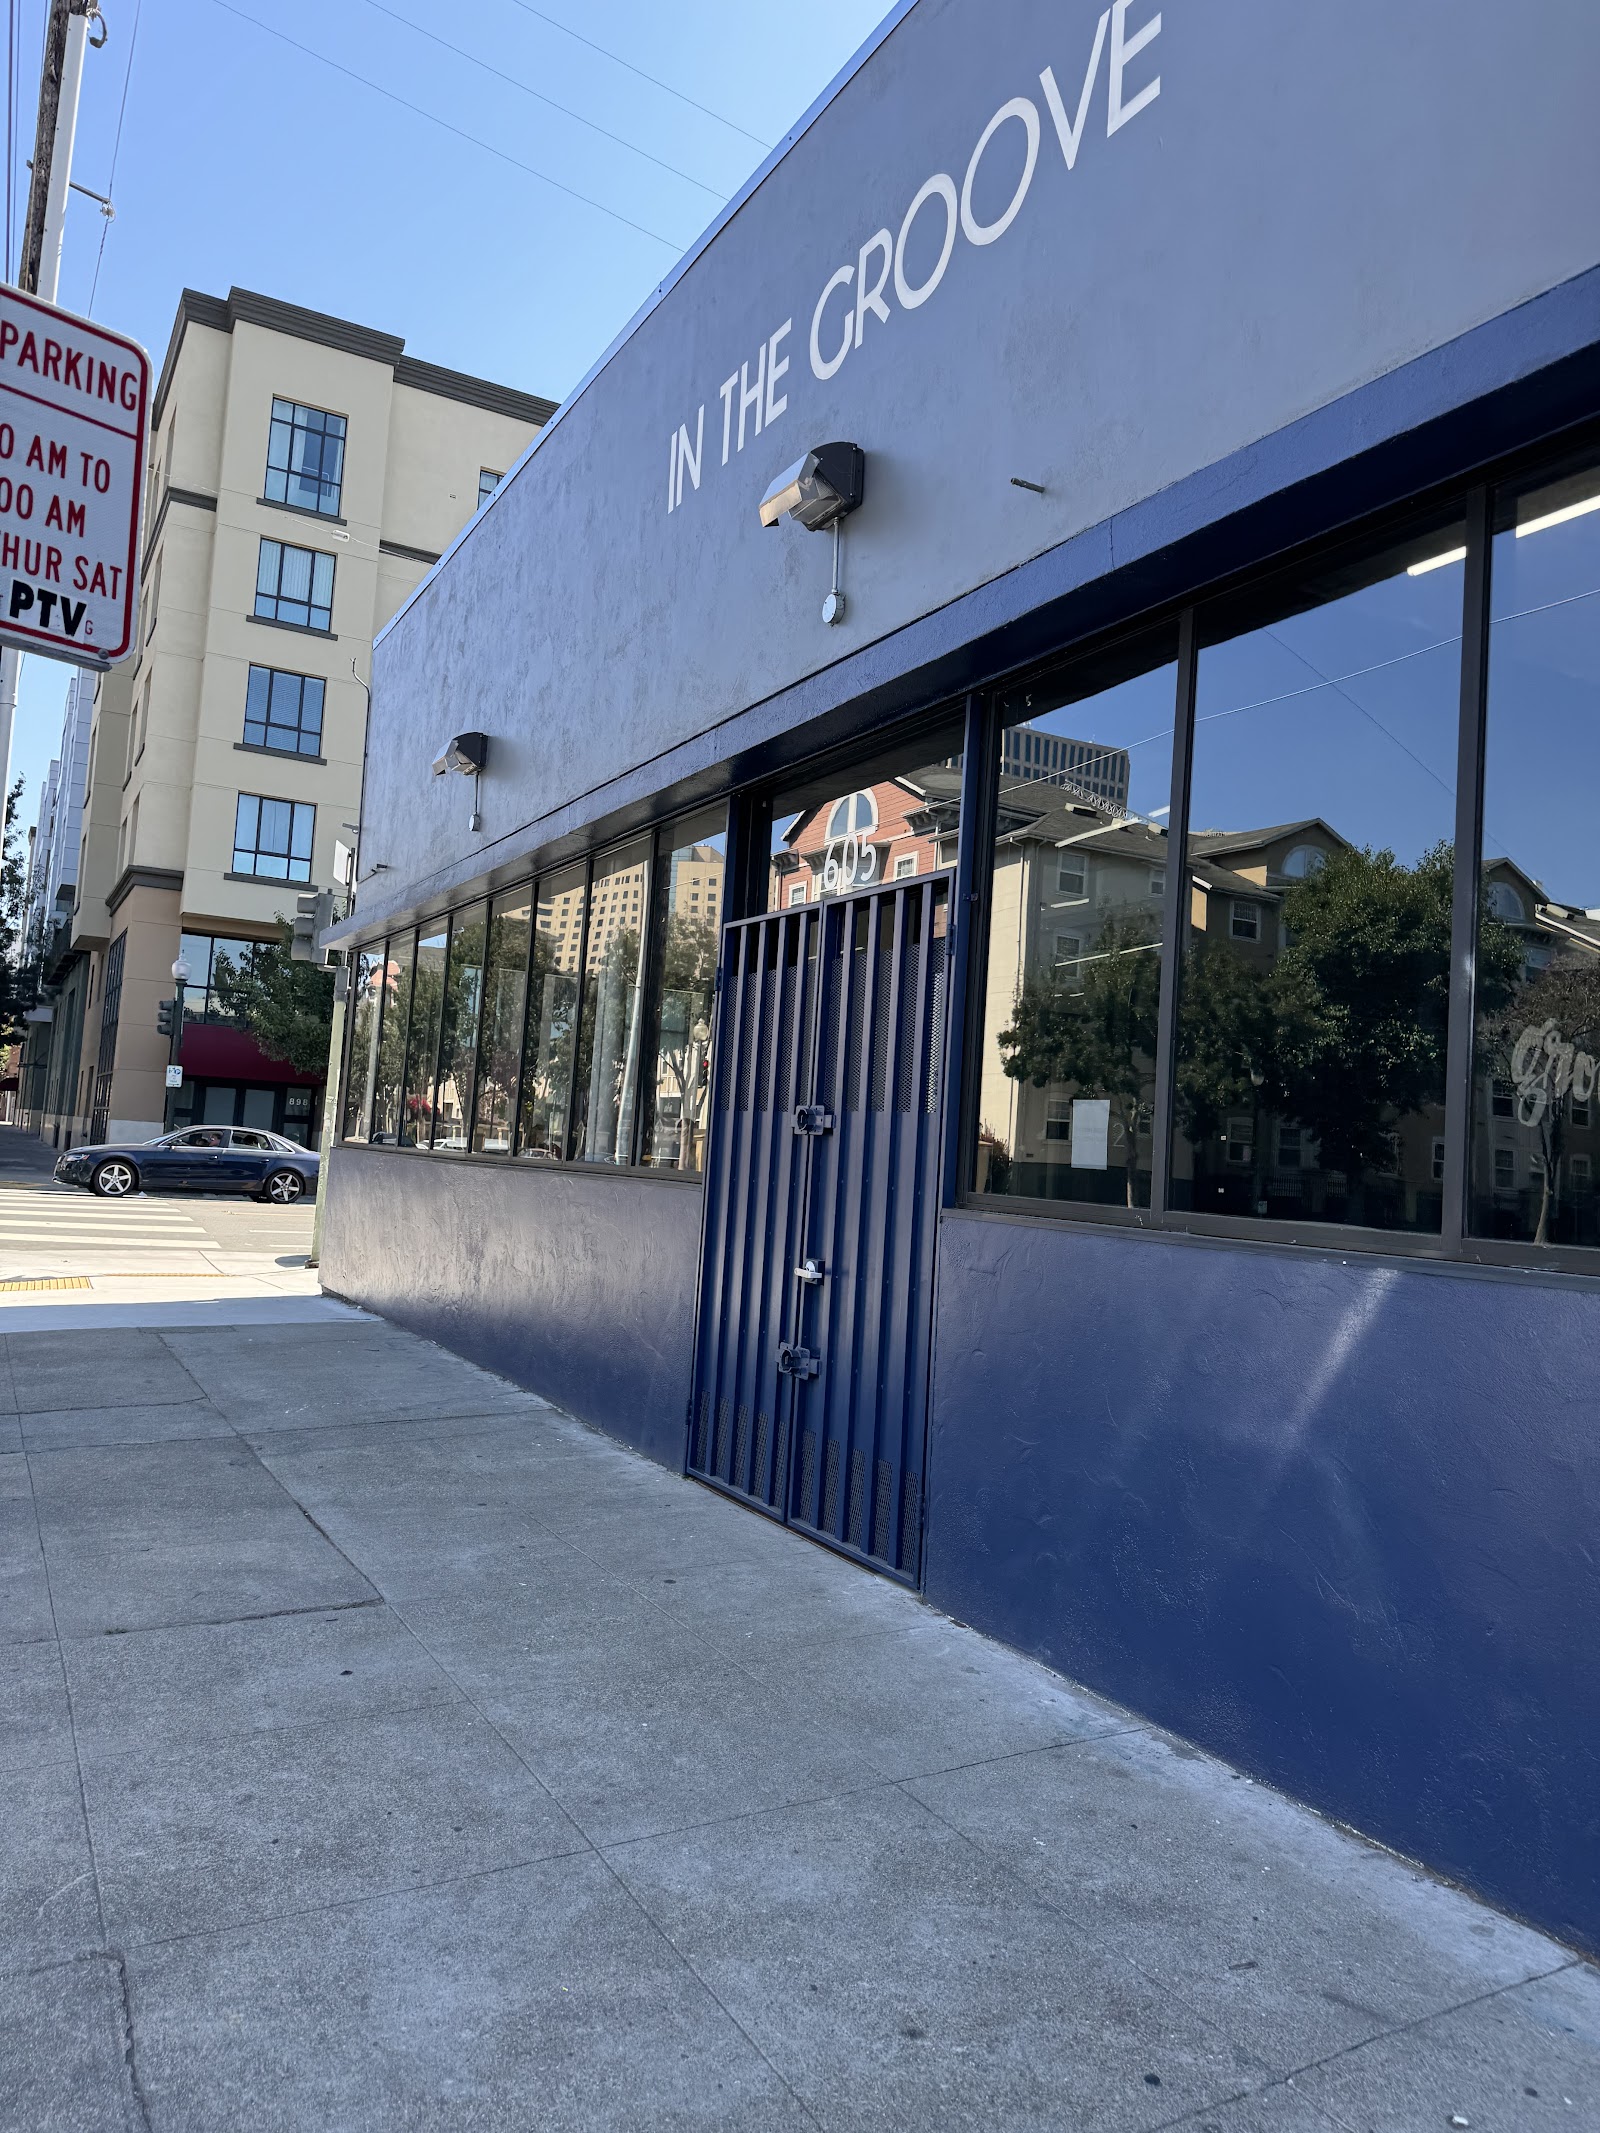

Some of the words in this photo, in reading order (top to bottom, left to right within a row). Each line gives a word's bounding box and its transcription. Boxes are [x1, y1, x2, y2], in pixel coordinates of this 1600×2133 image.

[667, 404, 705, 514] IN
[720, 317, 792, 466] THE
[809, 0, 1162, 380] GROOVE
[0, 319, 138, 411] PARKING
[26, 435, 68, 479] AM
[80, 452, 110, 493] TO
[45, 495, 86, 538] AM
[0, 531, 62, 583] HUR
[73, 556, 123, 600] SAT
[9, 579, 88, 637] PTV
[823, 828, 877, 890] 605
[288, 1097, 308, 1106] 898
